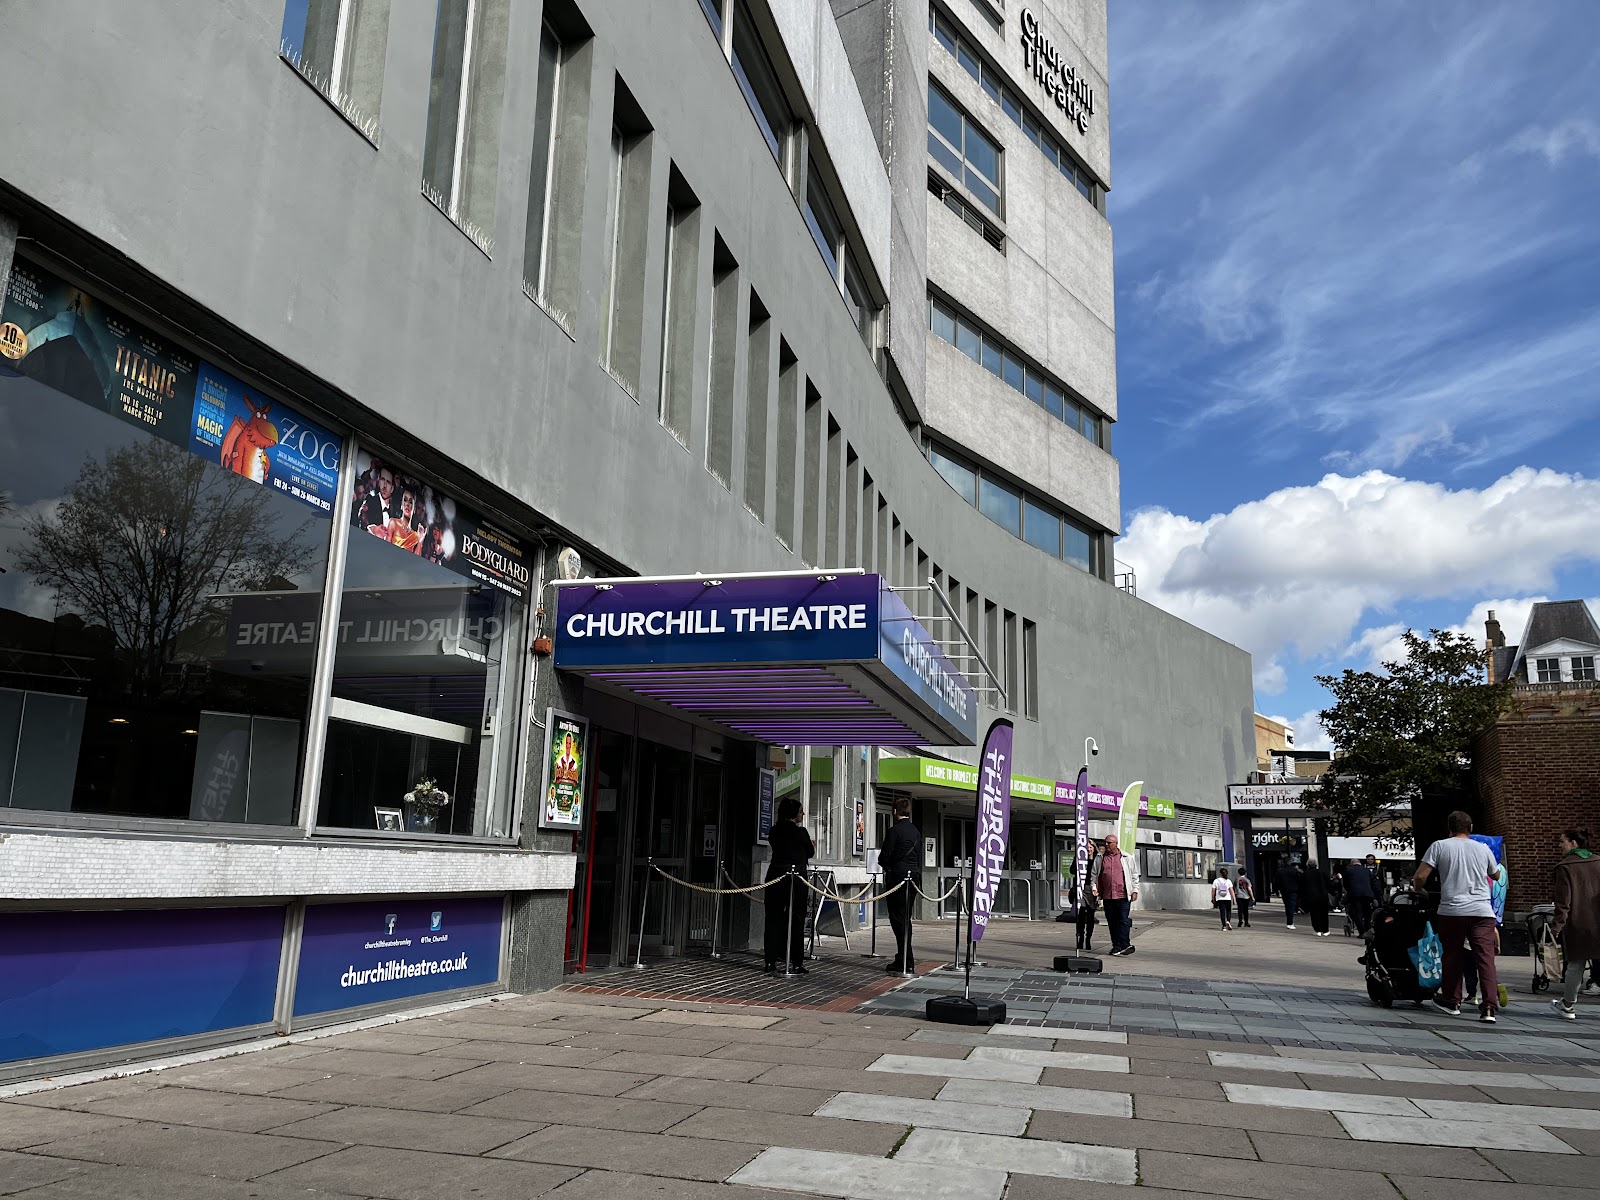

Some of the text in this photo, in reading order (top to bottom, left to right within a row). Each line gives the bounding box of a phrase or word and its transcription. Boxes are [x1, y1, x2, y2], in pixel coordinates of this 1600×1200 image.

[1021, 8, 1095, 116] Churchill
[1021, 34, 1088, 135] Theatre
[3, 325, 24, 345] 10TH
[115, 344, 177, 399] TITANIC
[123, 379, 162, 404] THE MUSICAL
[120, 393, 131, 404] THU
[144, 404, 155, 416] SAT
[123, 404, 157, 426] MARCH 2023
[196, 428, 203, 437] OF
[203, 431, 222, 446] THEATRE
[197, 413, 224, 438] MAGIC
[279, 417, 341, 472] ZOG
[291, 474, 300, 484] LIVE
[273, 477, 282, 488] FRI
[281, 481, 289, 491] 24
[291, 485, 300, 497] SUN
[300, 489, 307, 500] 26
[306, 493, 320, 507] MARCH
[320, 499, 331, 511] 2023
[462, 534, 529, 582] BODYGUARD
[566, 604, 867, 638] CHURCHILL THEATRE
[903, 627, 967, 721] CHURCHILL THEATRE
[926, 764, 946, 779] WELCOME
[946, 768, 952, 780] TO
[953, 769, 971, 783] BROMLEY
[1234, 796, 1274, 807] Marigold
[1245, 788, 1263, 796] Best
[973, 748, 998, 914] THEATRE
[364, 938, 412, 949] churchilltheatrebromley
[420, 934, 448, 944] @The_Churchill
[340, 951, 469, 987] churchilltheatre.co.uk
